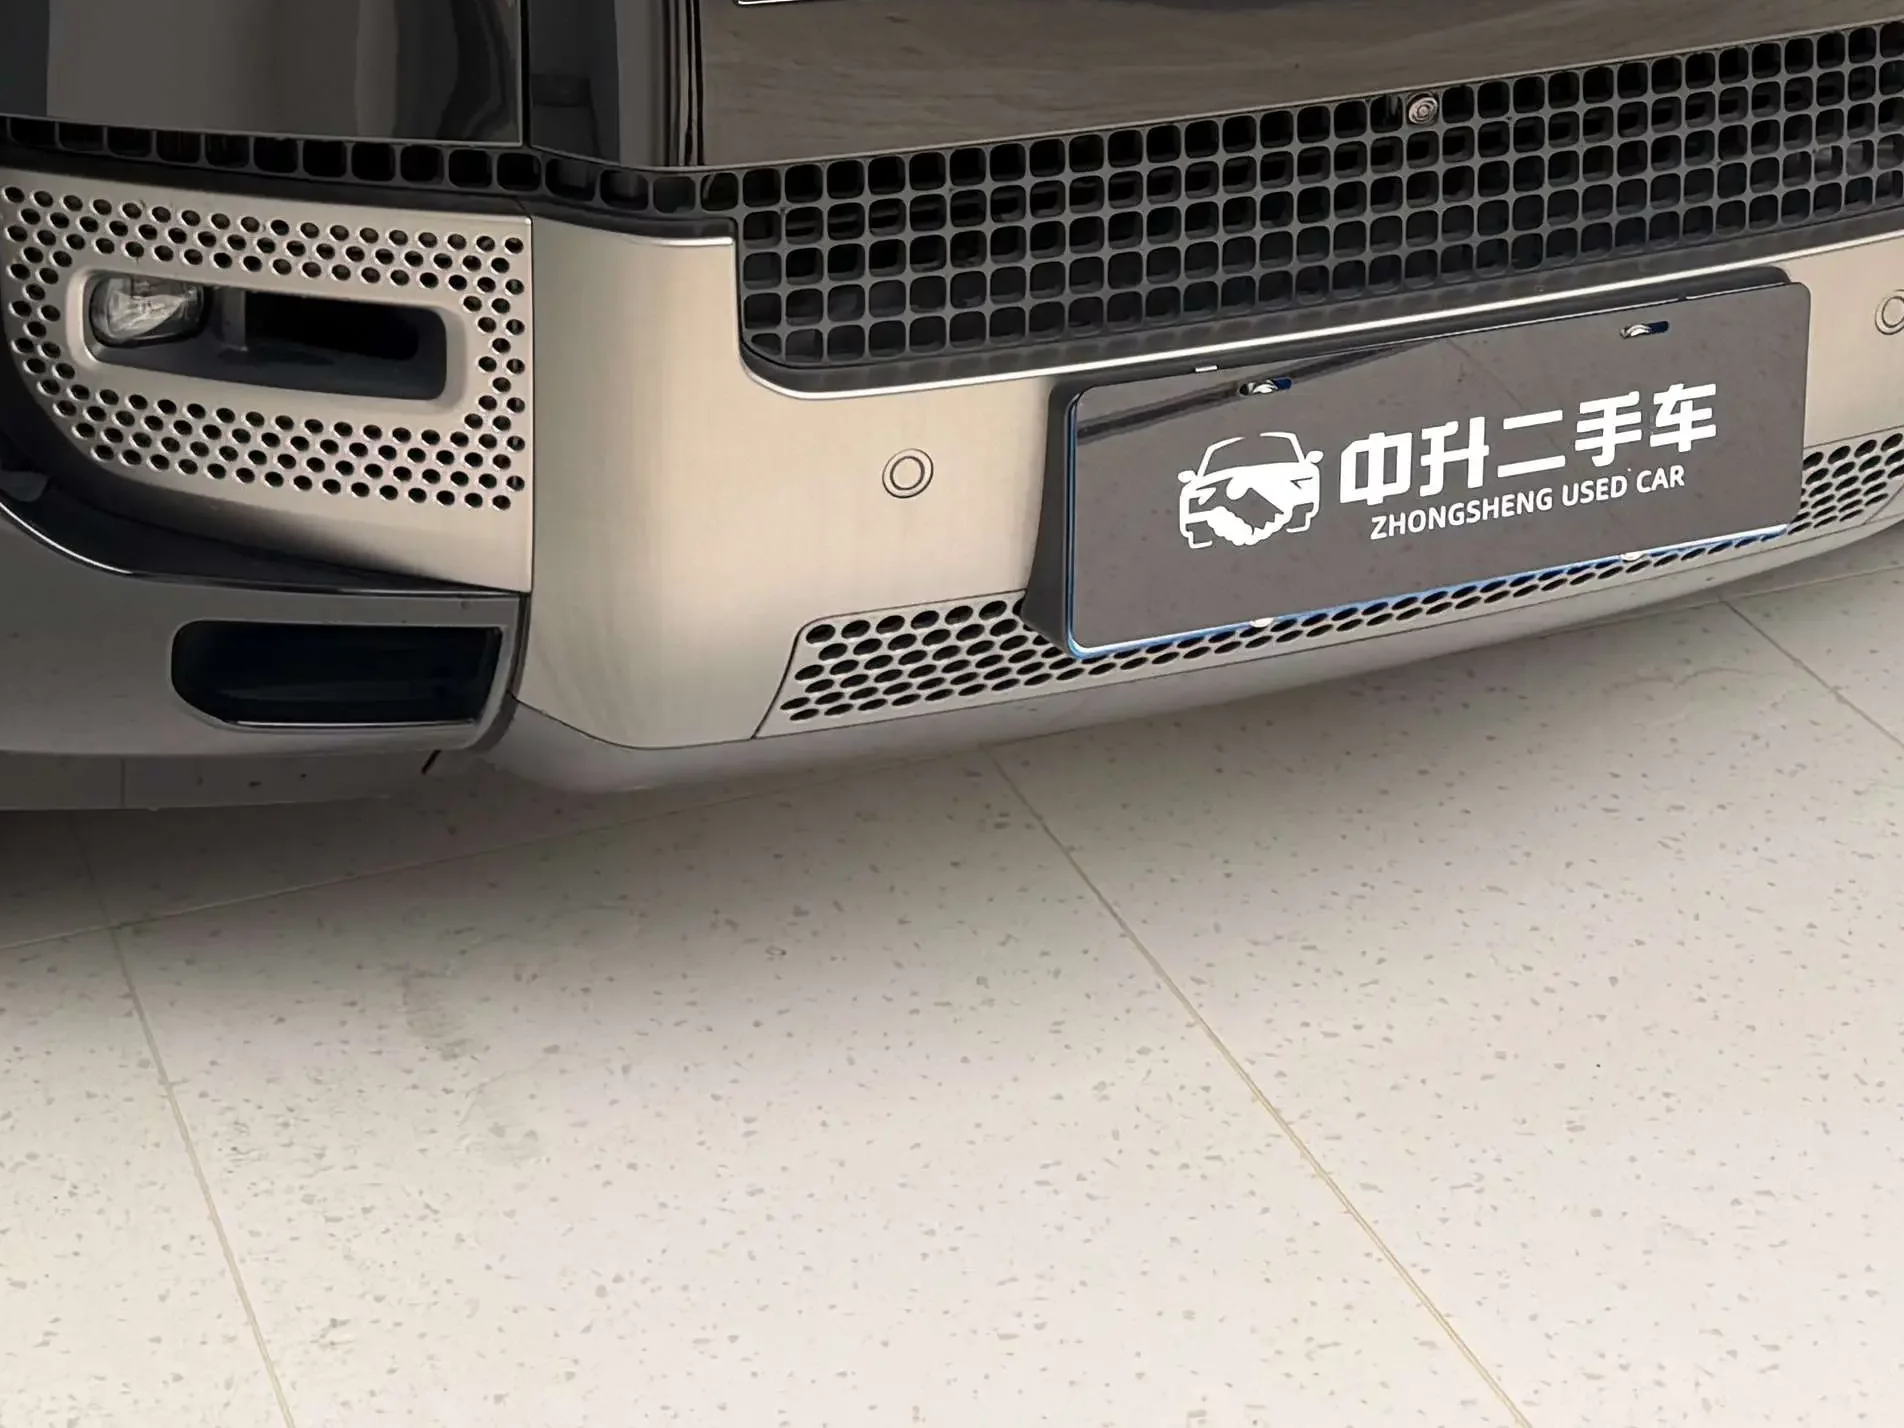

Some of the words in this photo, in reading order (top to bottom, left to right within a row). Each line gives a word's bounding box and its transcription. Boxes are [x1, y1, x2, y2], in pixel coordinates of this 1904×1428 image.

[1339, 383, 1717, 506] 中升二手车
[1370, 487, 1554, 540] ZHONGSHENG
[1561, 474, 1629, 507] USED
[1636, 464, 1685, 494] CAR
